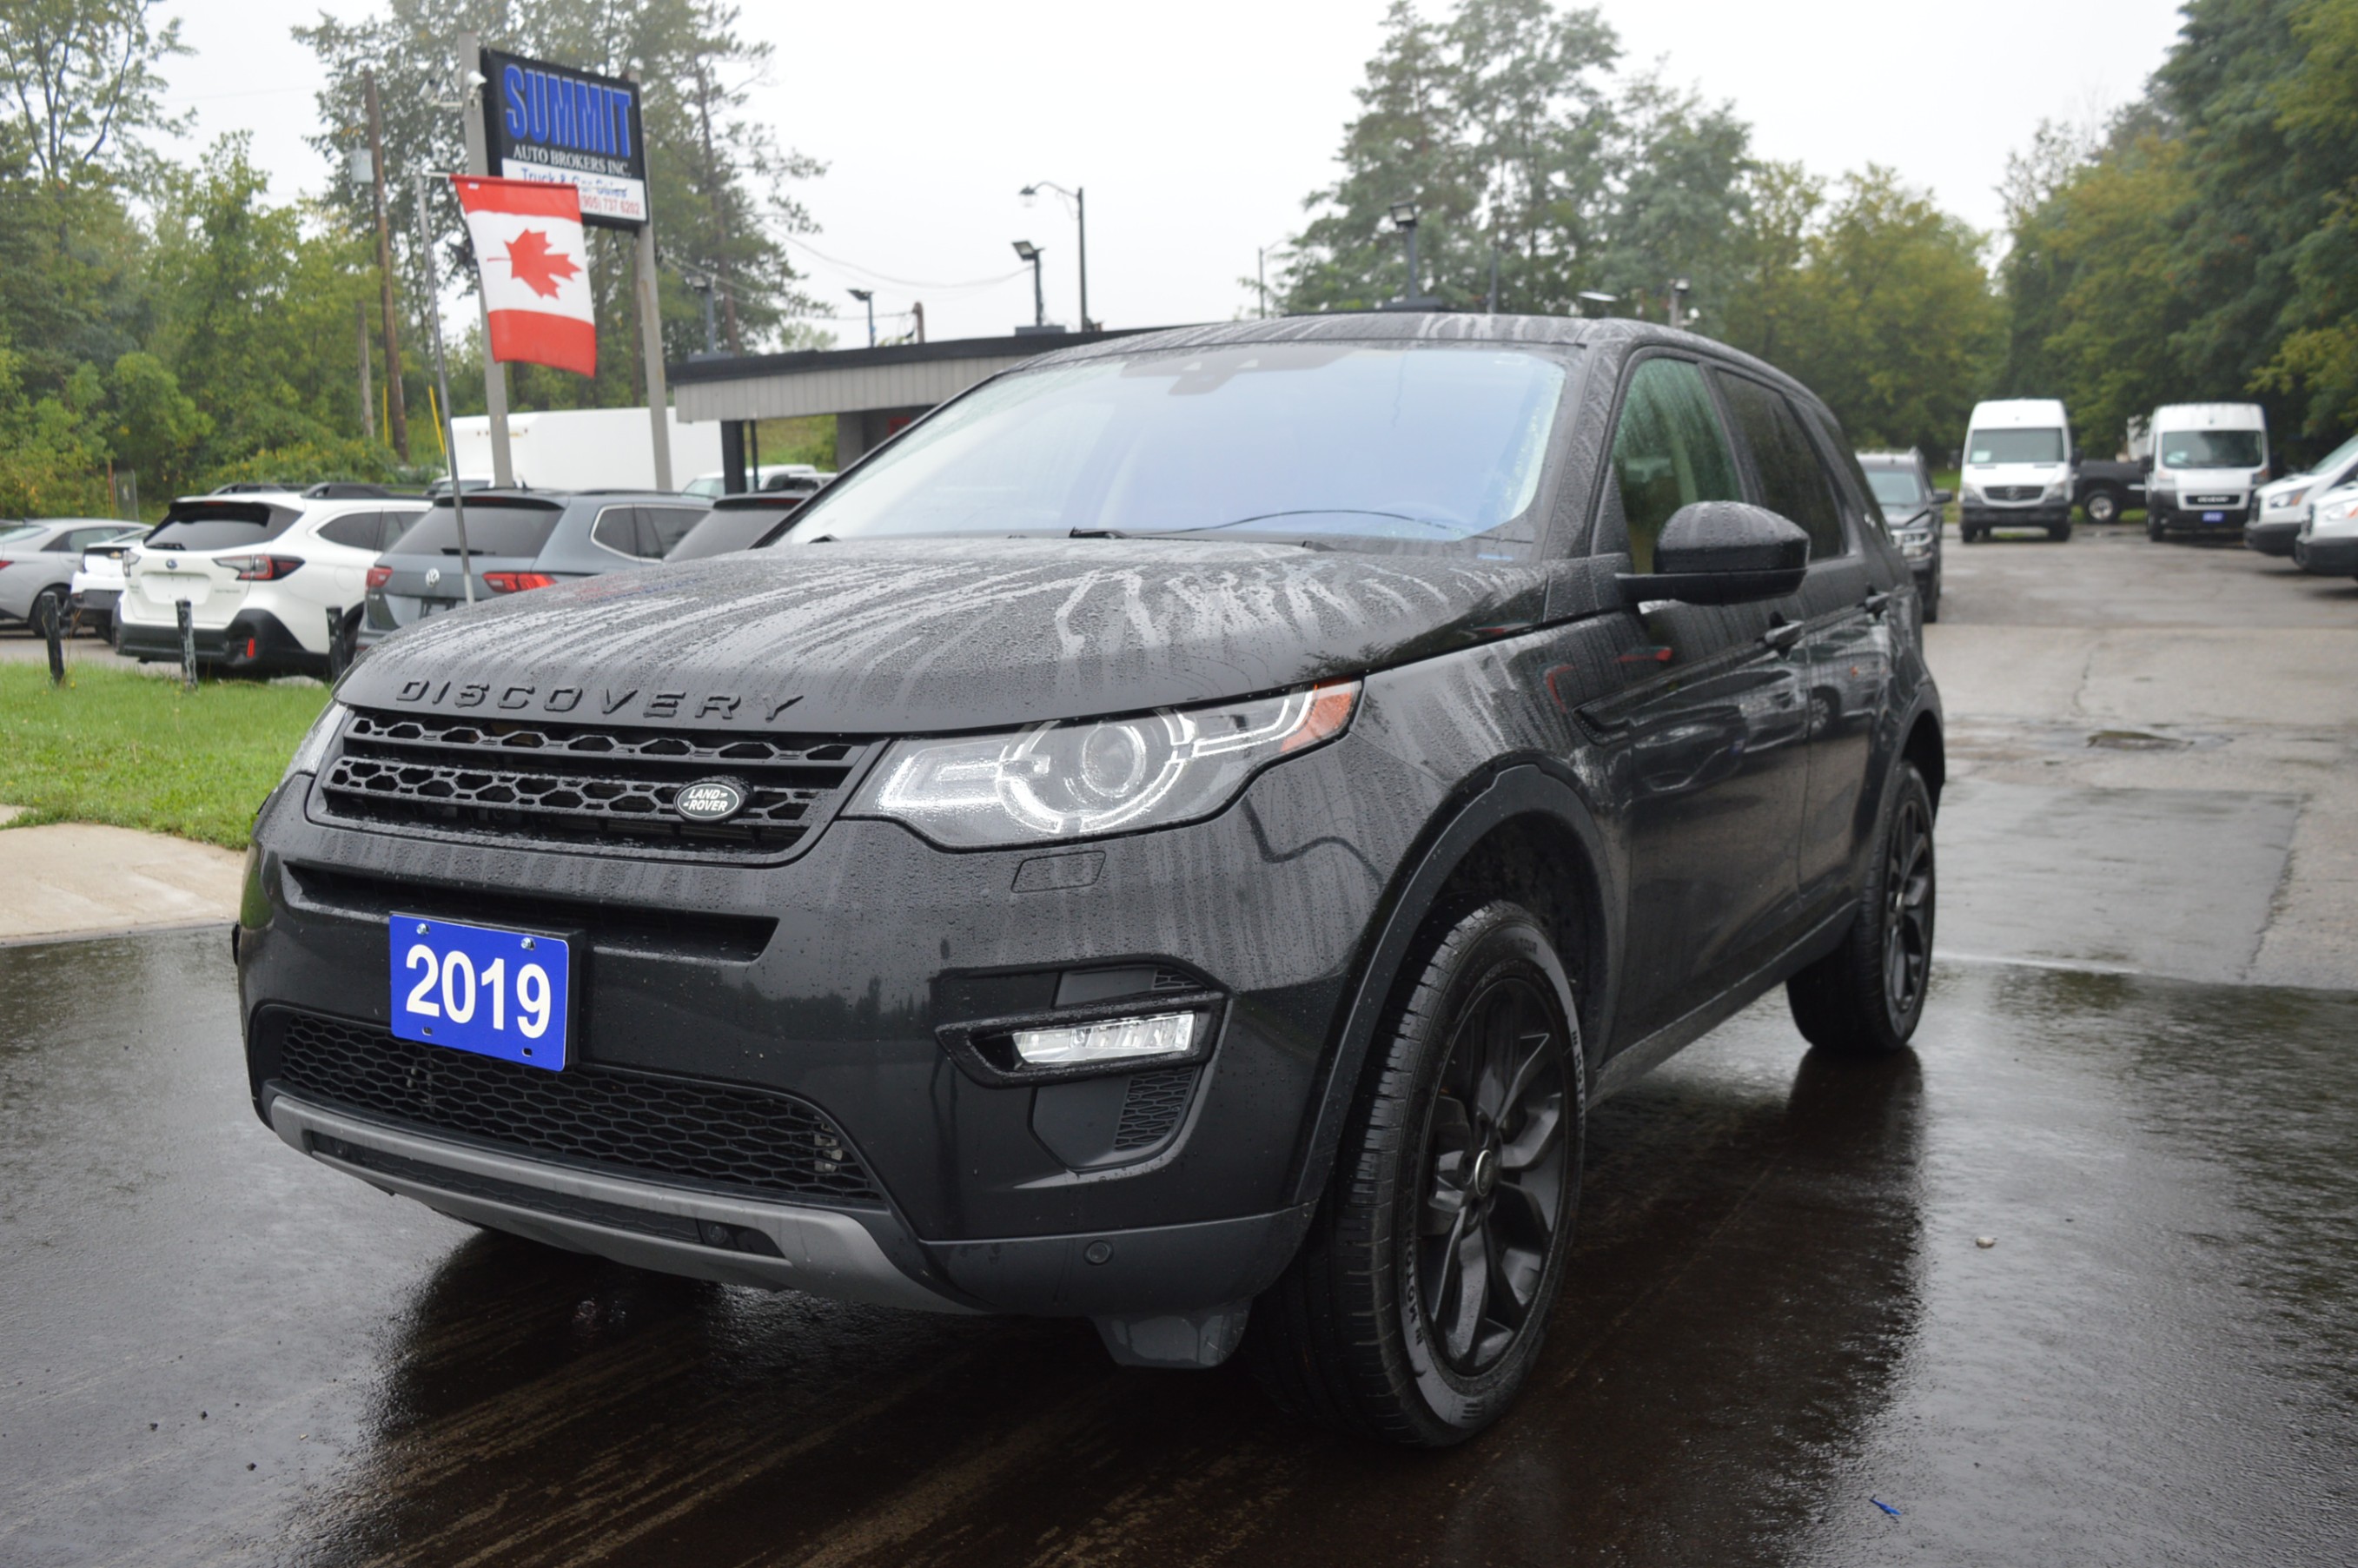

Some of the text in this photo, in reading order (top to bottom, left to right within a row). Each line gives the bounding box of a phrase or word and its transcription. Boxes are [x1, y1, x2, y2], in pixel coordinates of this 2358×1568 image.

[503, 63, 632, 158] SUMMIT
[513, 143, 633, 178] AUTO BROKERS INC.
[396, 680, 804, 723] DISCOVERY
[688, 789, 721, 799] LAND
[688, 799, 728, 812] ROVER
[406, 944, 551, 1038] 2019
